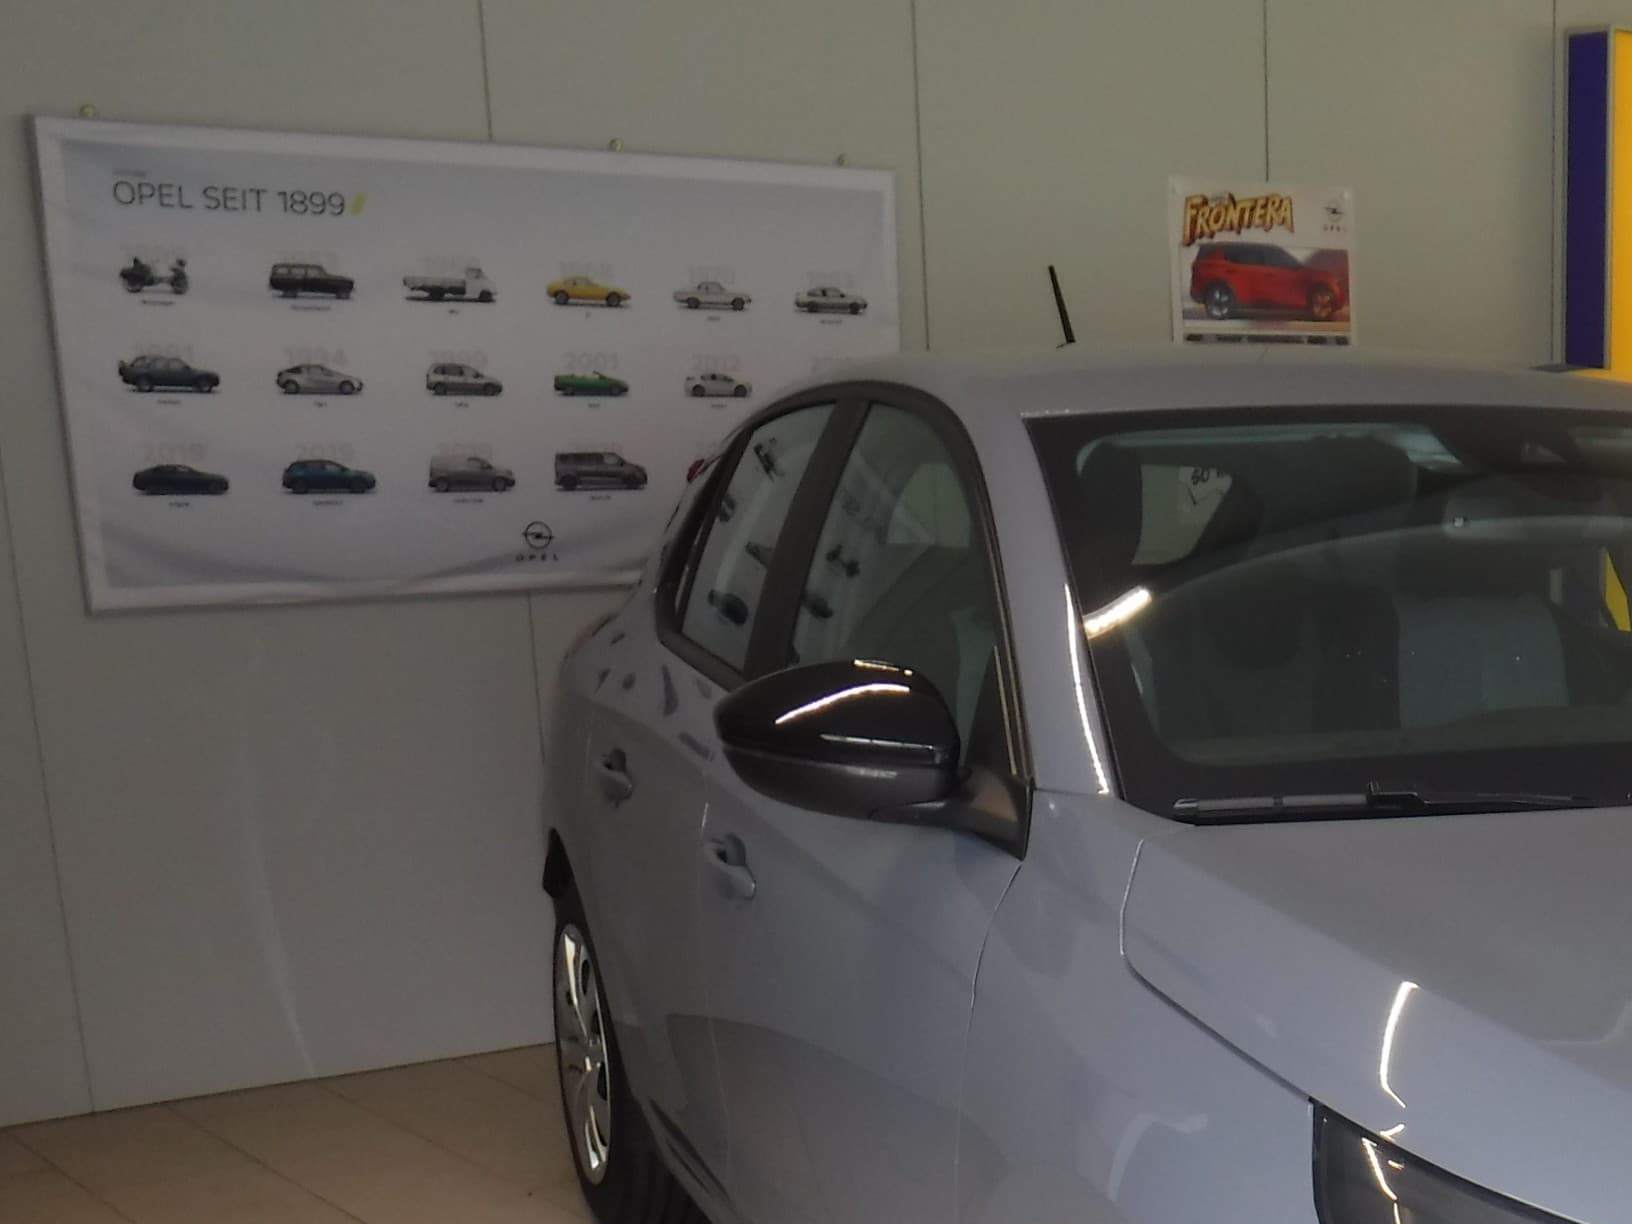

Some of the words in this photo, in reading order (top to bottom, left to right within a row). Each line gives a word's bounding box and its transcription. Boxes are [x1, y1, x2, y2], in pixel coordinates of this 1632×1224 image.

[113, 181, 195, 209] OPEL
[203, 186, 267, 212] SEIT
[277, 191, 345, 216] 1899
[1182, 193, 1294, 246] FRONTERA
